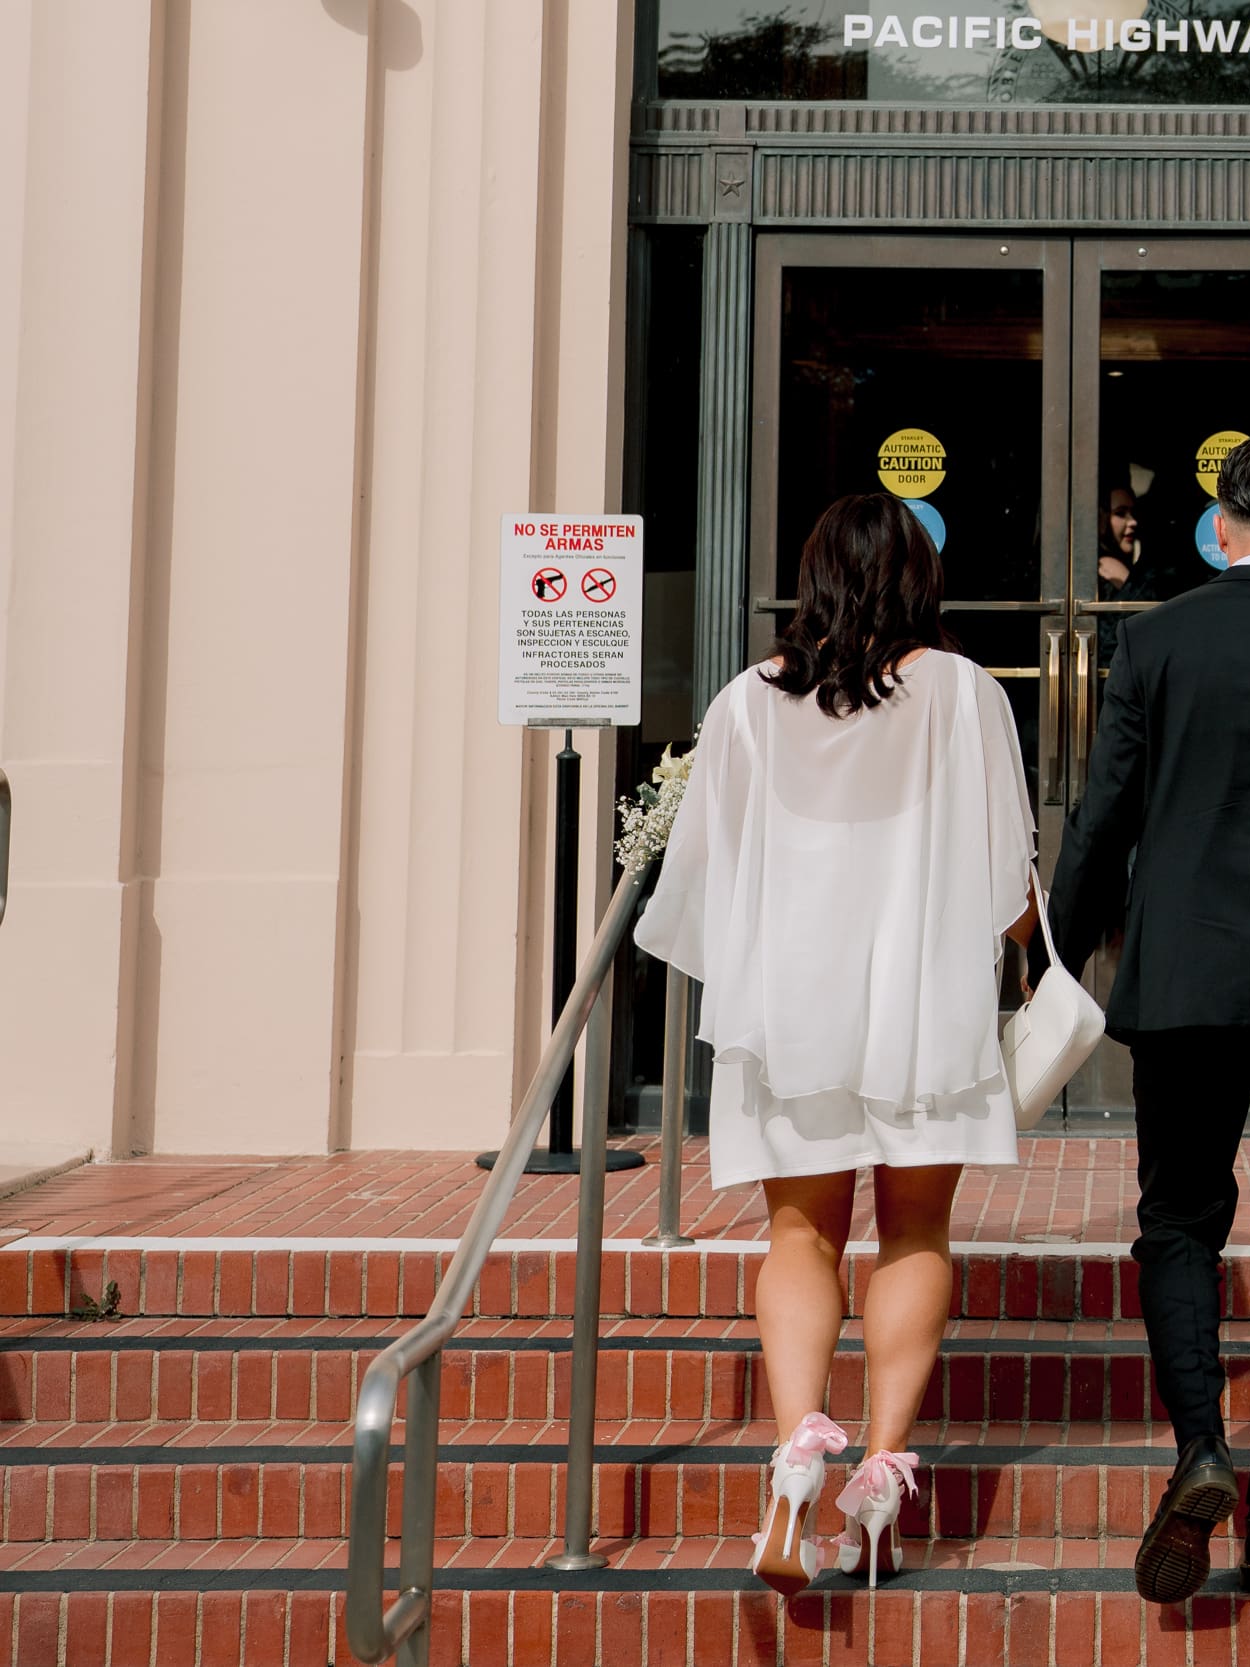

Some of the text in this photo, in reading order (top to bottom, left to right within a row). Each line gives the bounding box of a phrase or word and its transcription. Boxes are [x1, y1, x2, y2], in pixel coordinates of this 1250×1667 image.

[843, 14, 1042, 50] PACIFIC
[884, 444, 941, 453] AUTOMATIC
[1202, 446, 1231, 456] AUTO
[880, 457, 943, 470] CAUTION
[898, 474, 926, 483] DOOR
[514, 523, 635, 538] NO SE PERMITEN
[545, 538, 604, 551] ARMAS
[521, 610, 626, 618] TODAS LAS PERSONAS
[553, 620, 624, 628] PERTENENCIAS
[516, 629, 535, 637] SON
[537, 629, 576, 637] SUJETAS
[586, 629, 631, 639] ESCANEO,
[517, 639, 629, 647] INSPECCION Y ESCULQUE
[522, 650, 624, 659] INFRACTORES SERAN
[540, 660, 606, 668] PROCESADOS
